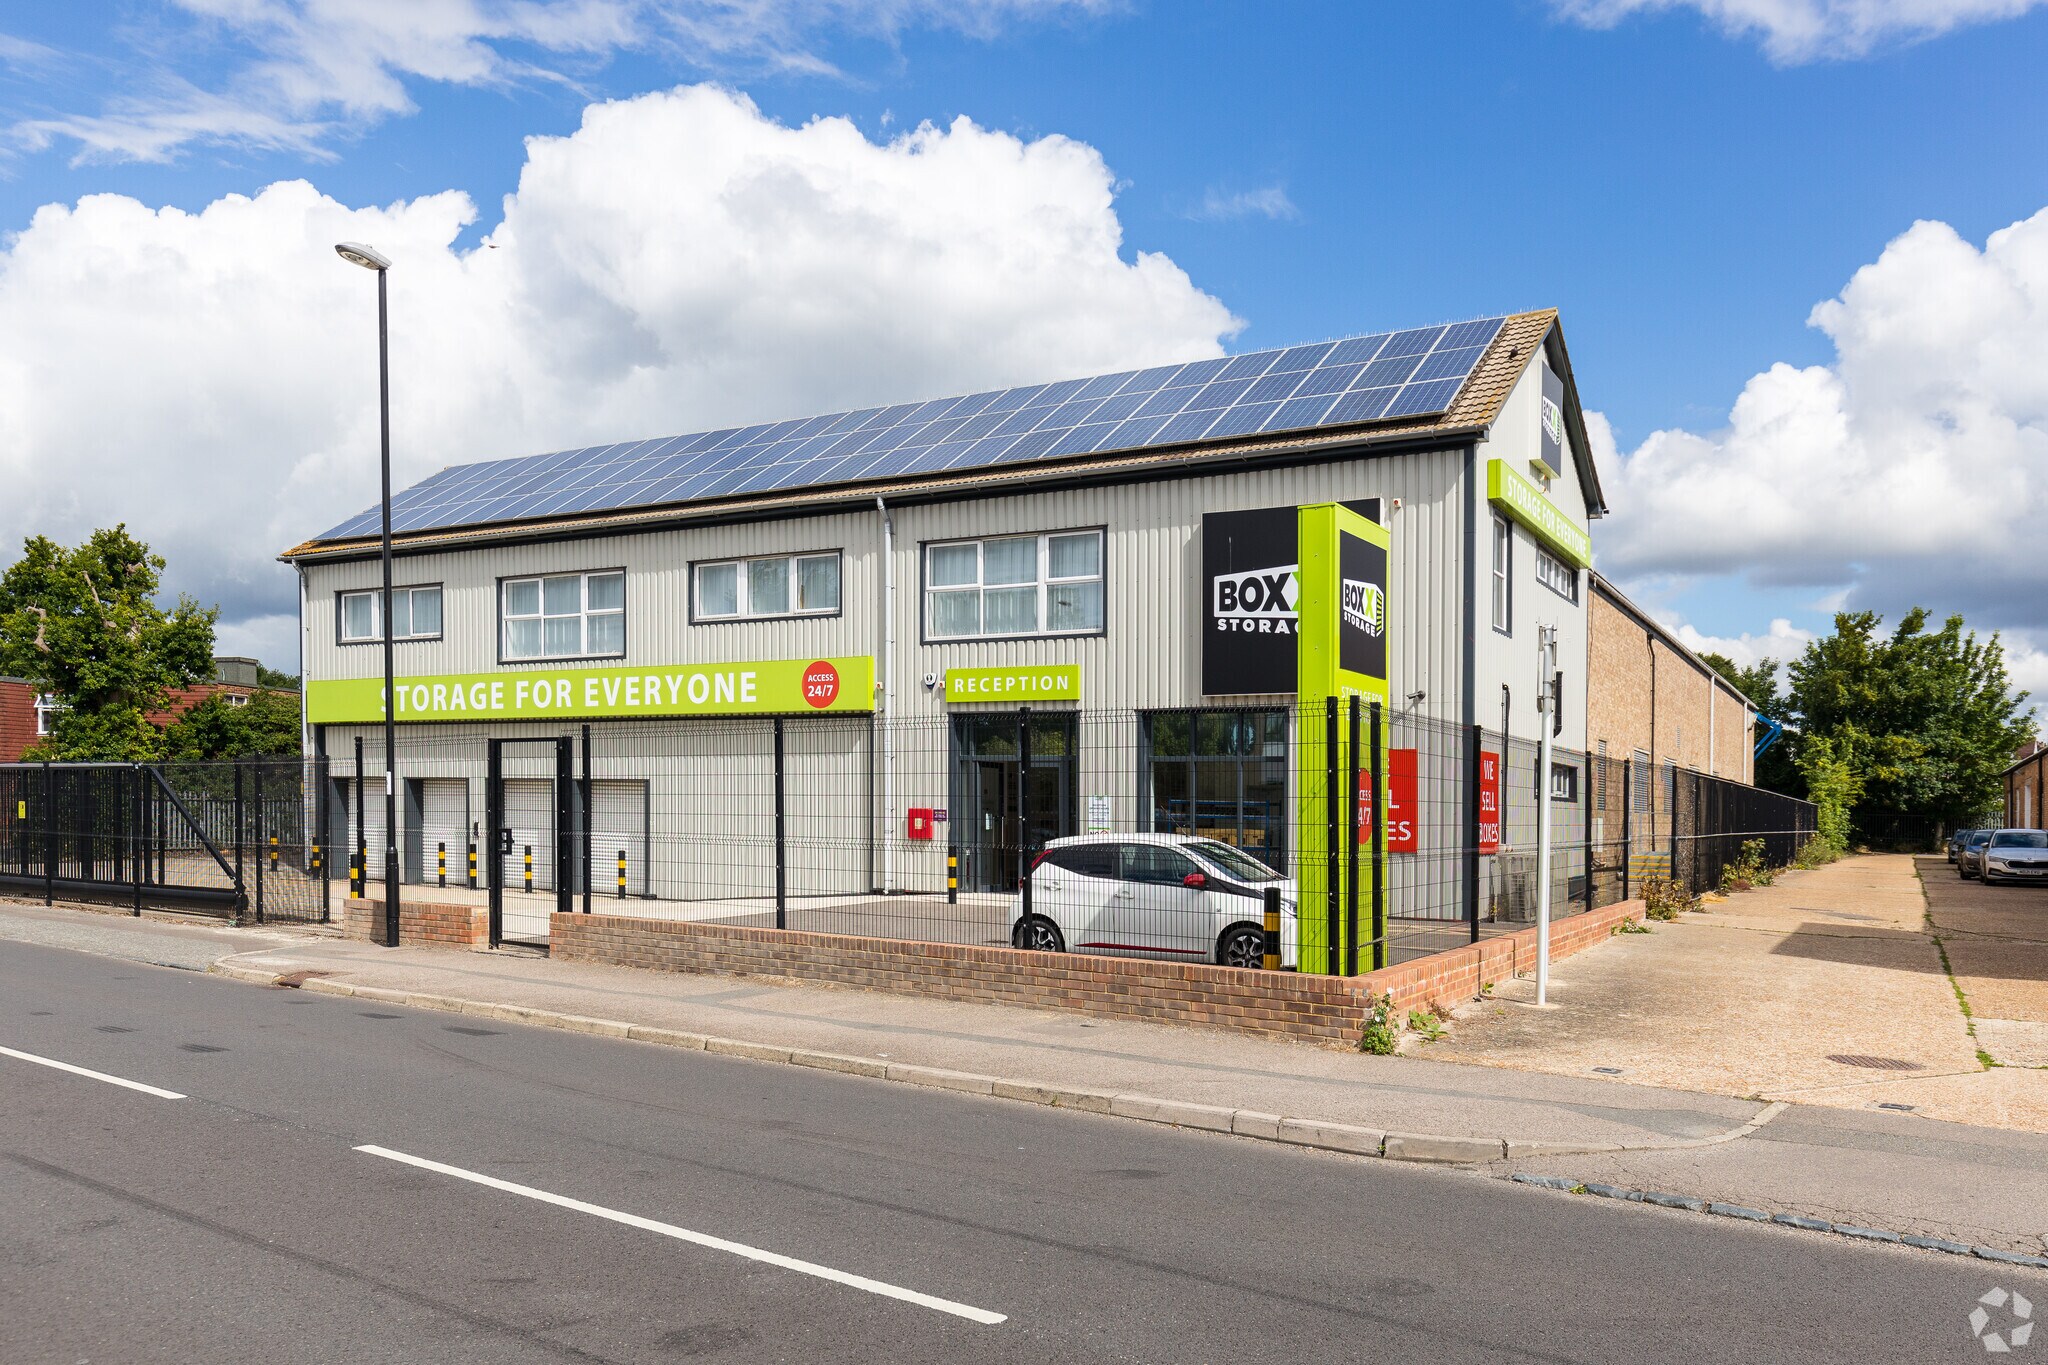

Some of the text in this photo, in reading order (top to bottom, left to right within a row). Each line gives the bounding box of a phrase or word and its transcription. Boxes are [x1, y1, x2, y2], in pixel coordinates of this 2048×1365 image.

[1508, 475, 1587, 558] STORAGE FOR EVERYONE
[1218, 572, 1298, 612] BOX
[1345, 583, 1374, 619] BOXX
[1217, 618, 1298, 635] STORA
[1343, 613, 1376, 638] STORAGE
[807, 673, 834, 682] ACCESS
[954, 675, 1069, 693] RECEPTION
[516, 679, 572, 709] FOR
[584, 671, 758, 708] EVERYONE
[807, 684, 834, 697] 24/7
[1483, 760, 1494, 780] WE
[1359, 789, 1371, 801] CESS
[1482, 791, 1496, 811] SELL
[1358, 806, 1371, 825] 4/7
